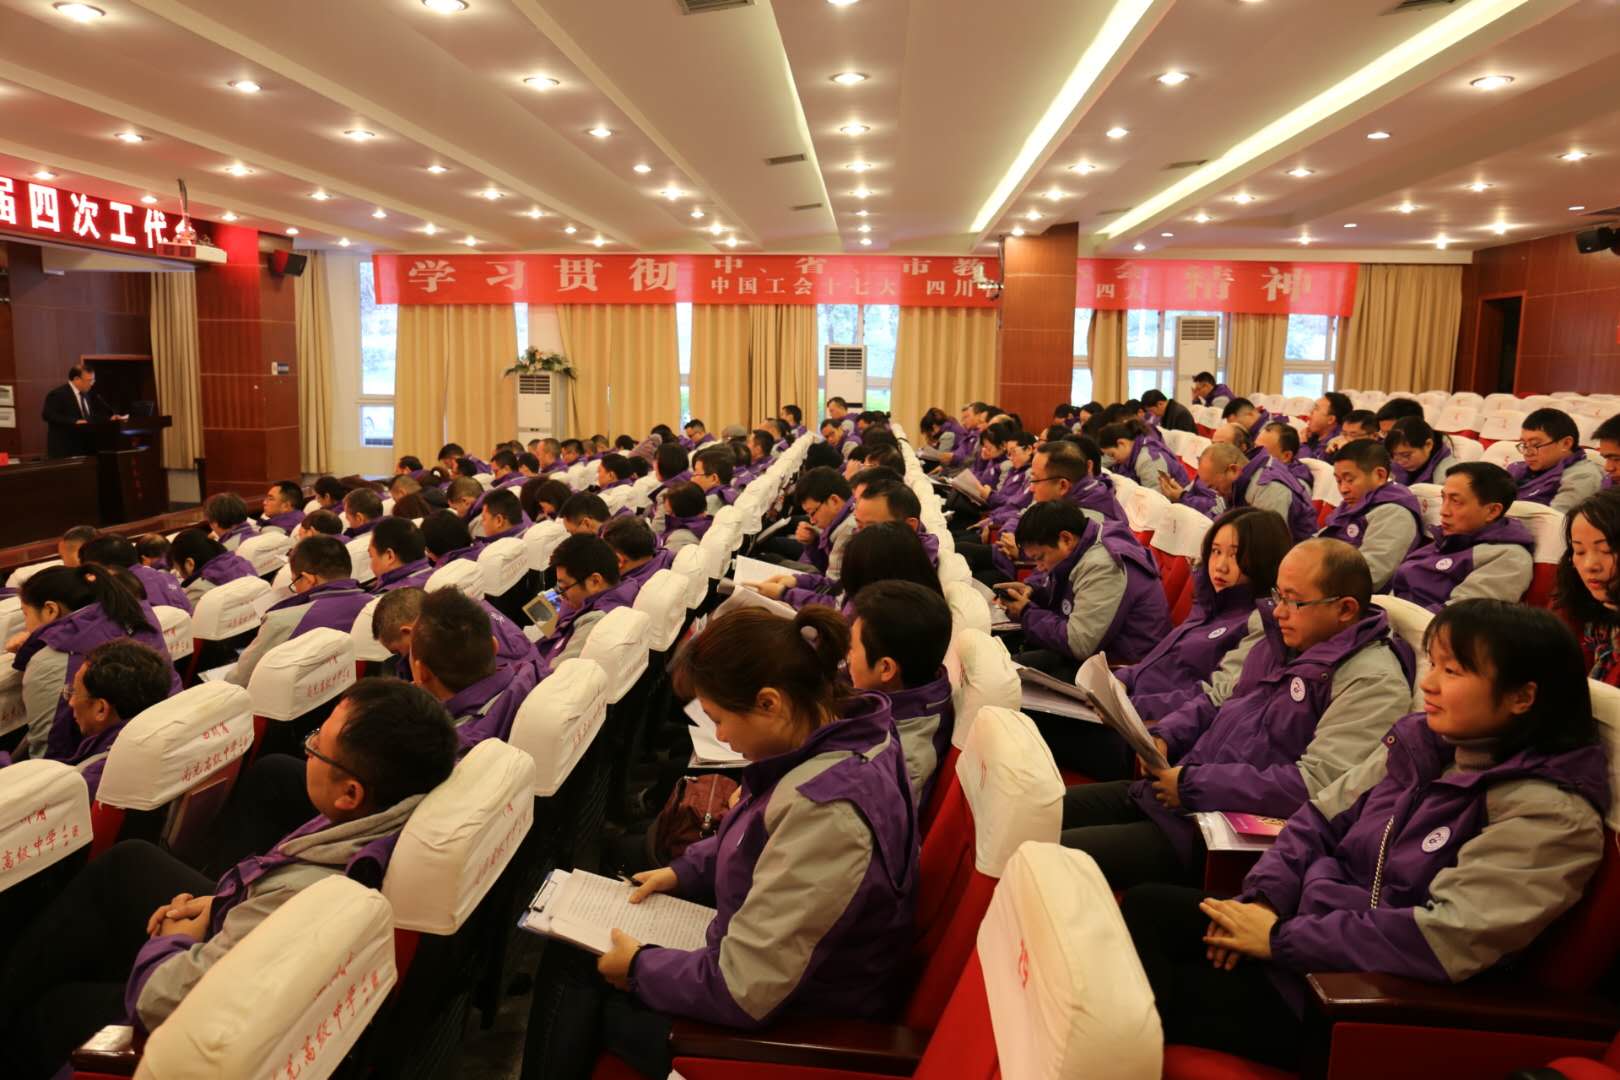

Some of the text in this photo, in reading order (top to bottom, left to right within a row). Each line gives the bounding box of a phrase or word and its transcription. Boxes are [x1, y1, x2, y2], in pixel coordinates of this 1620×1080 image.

[0, 176, 196, 248] 届四次工代
[408, 257, 679, 293] 学习贯彻
[1184, 264, 1313, 302] 精神
